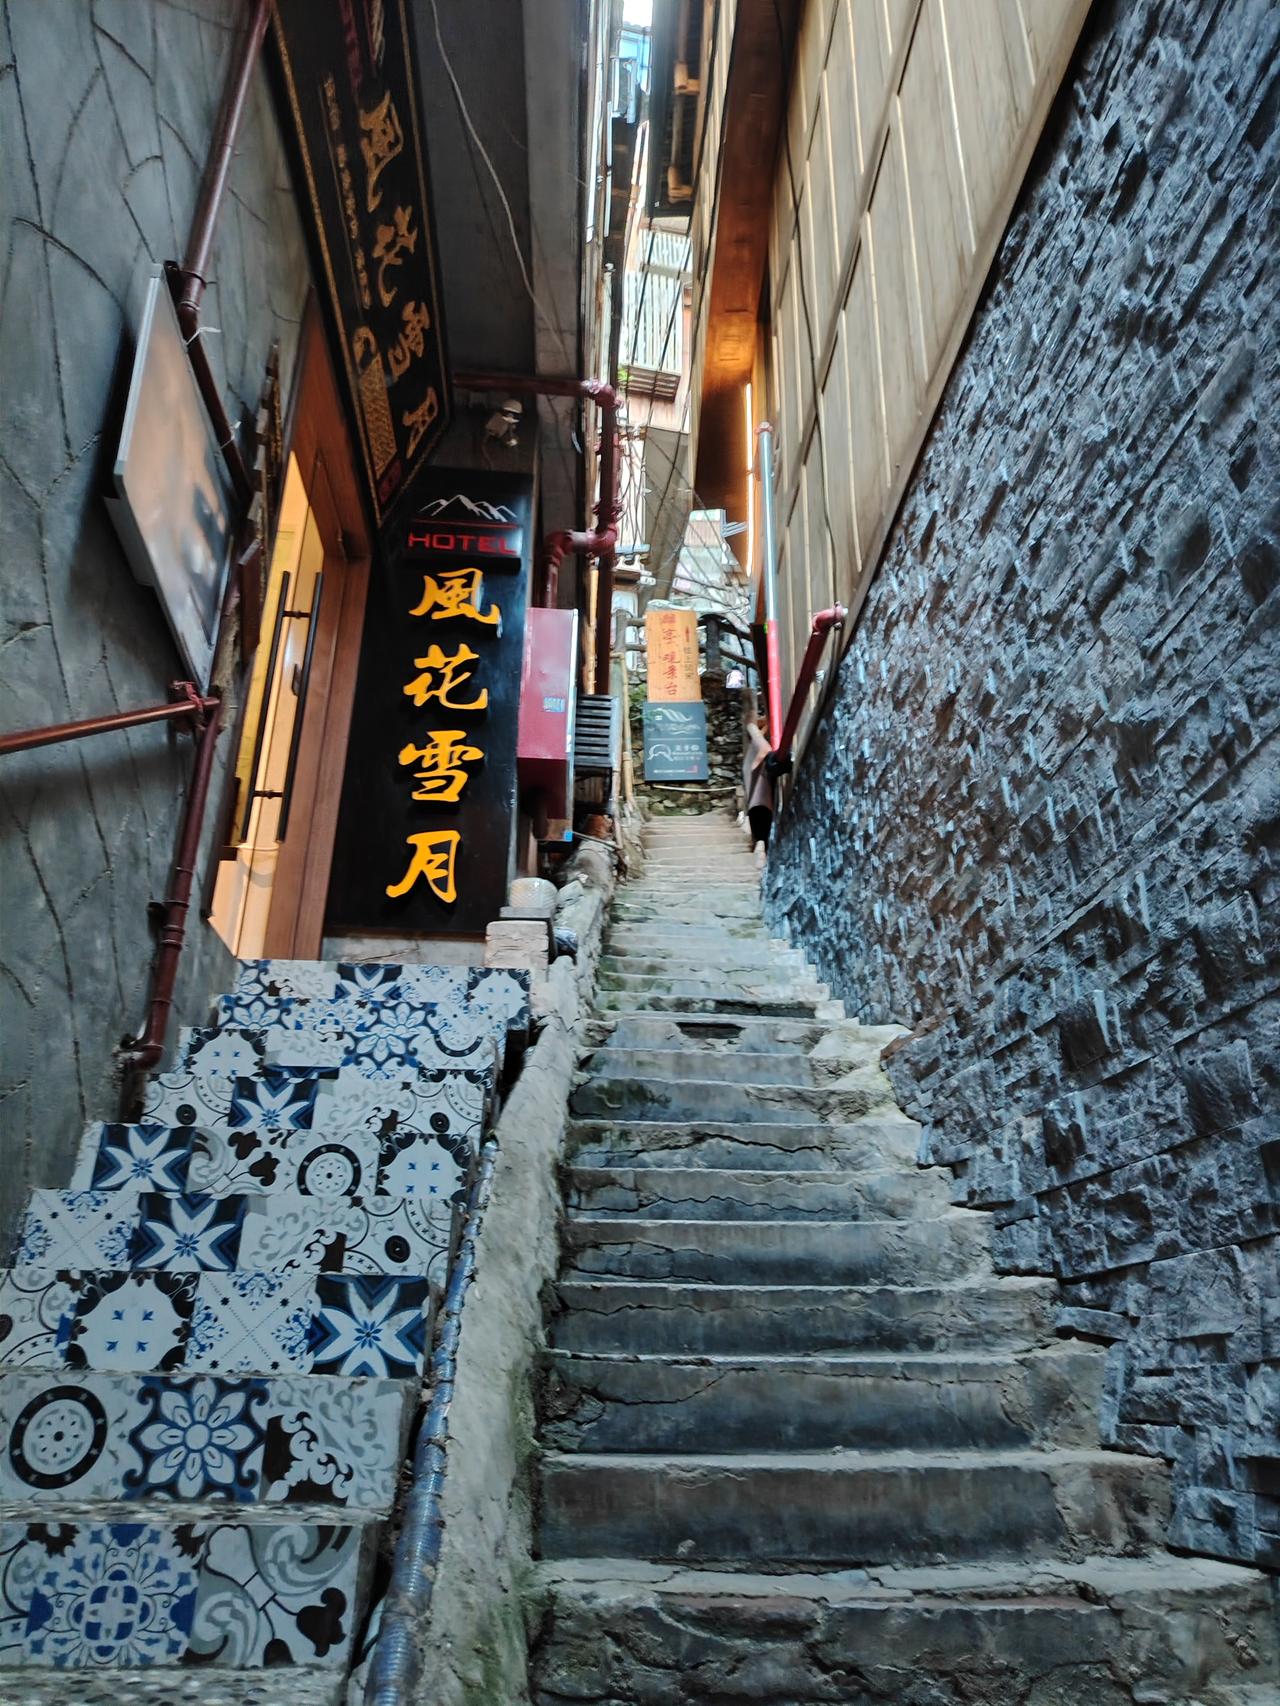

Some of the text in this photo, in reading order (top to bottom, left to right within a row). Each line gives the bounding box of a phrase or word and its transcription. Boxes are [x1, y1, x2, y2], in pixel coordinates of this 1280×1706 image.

[408, 532, 518, 555] HOTEL
[386, 567, 501, 903] 風花雪月
